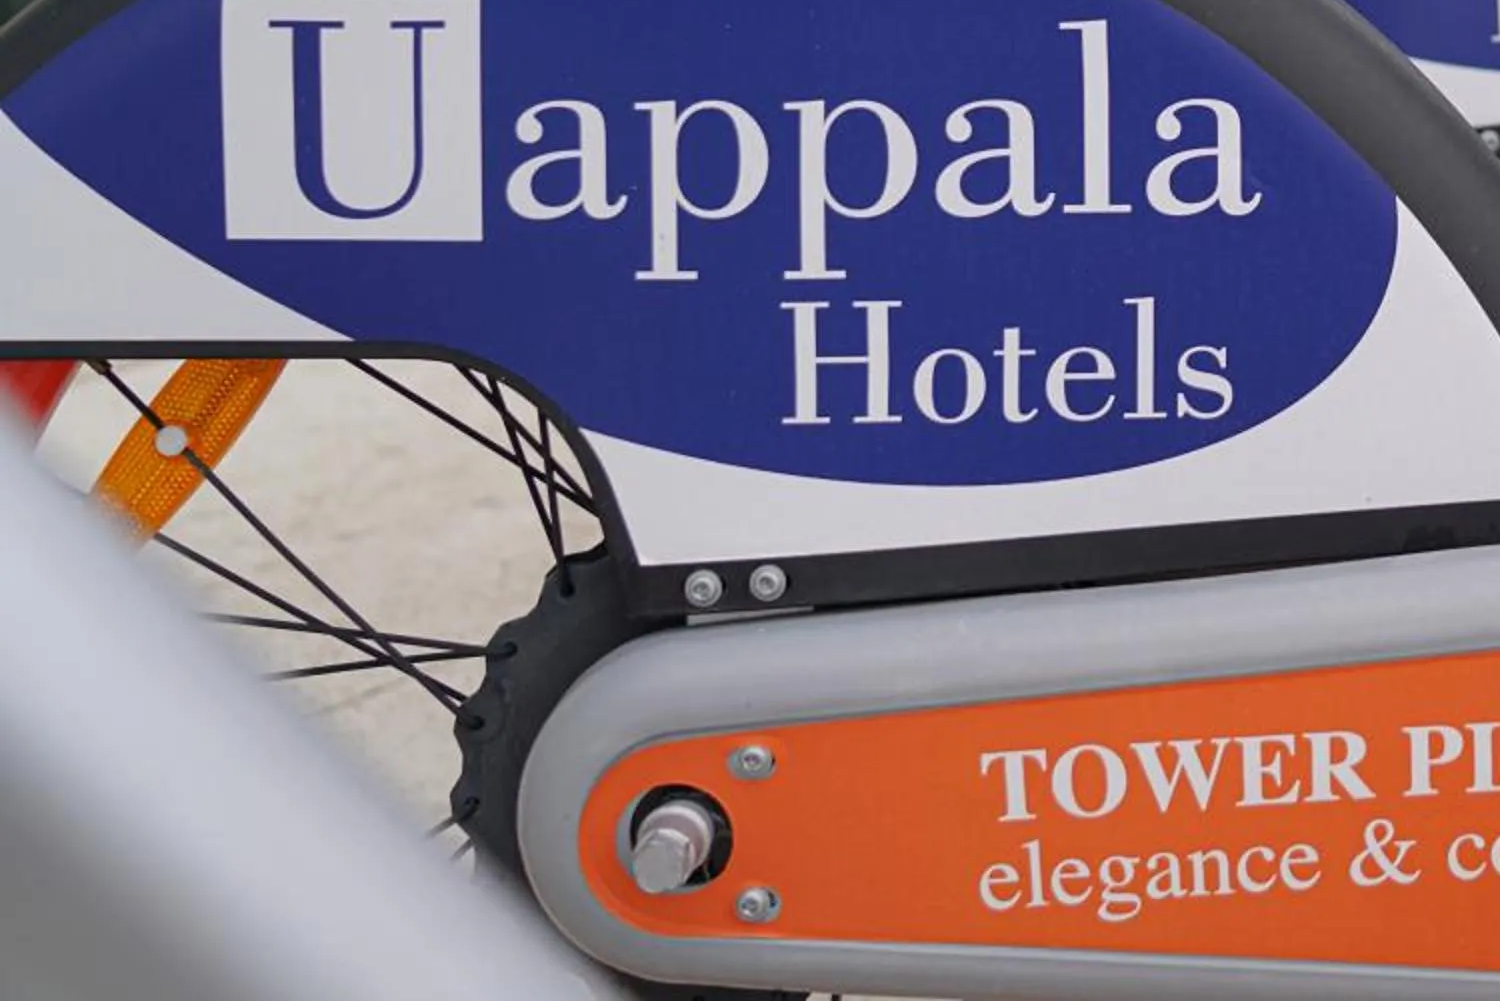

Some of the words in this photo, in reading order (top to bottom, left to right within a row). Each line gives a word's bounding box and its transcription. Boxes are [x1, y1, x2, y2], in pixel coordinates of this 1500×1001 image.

[266, 18, 1262, 281] Uappala
[779, 296, 1234, 425] Hotels
[980, 730, 1376, 823] TOWER
[979, 839, 1321, 923] elegance
[1348, 818, 1421, 887] &
